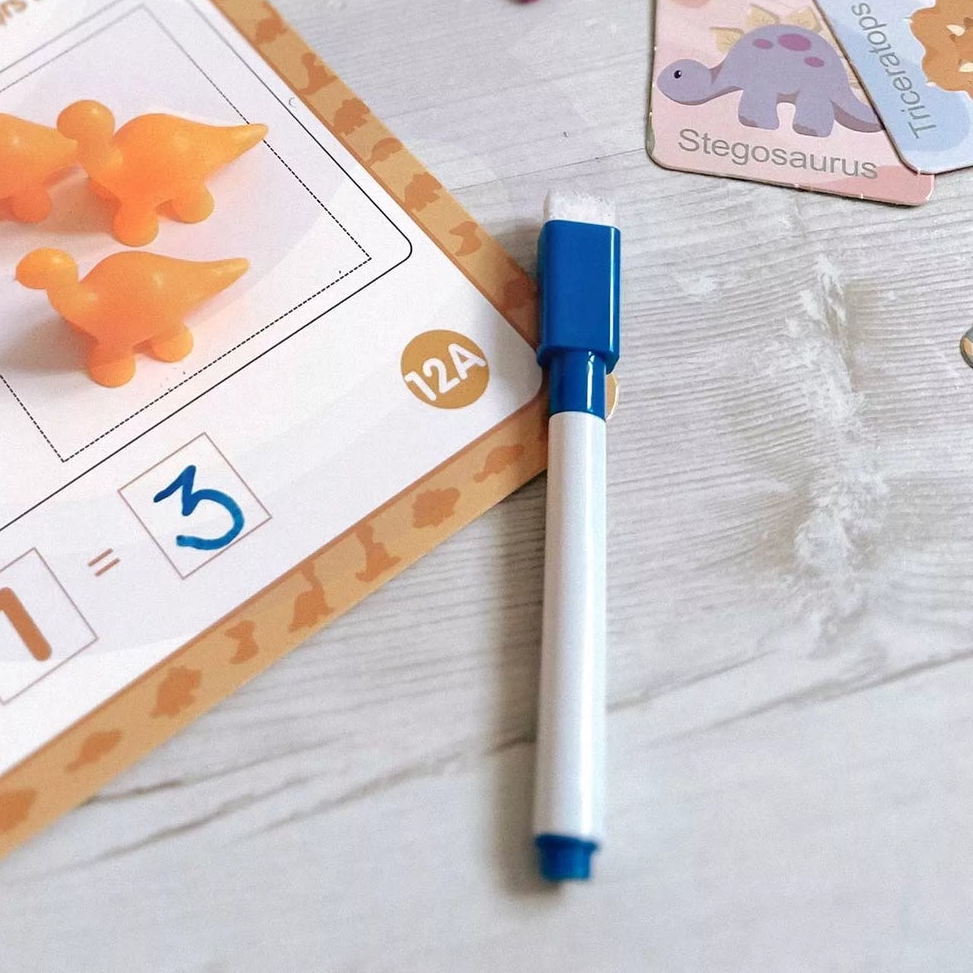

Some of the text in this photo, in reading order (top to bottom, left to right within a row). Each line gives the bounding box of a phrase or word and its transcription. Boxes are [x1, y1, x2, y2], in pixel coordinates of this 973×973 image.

[851, 1, 937, 140] Triceratops
[678, 128, 878, 179] Stegosaurus
[404, 343, 486, 401] 12A
[153, 464, 246, 551] 3
